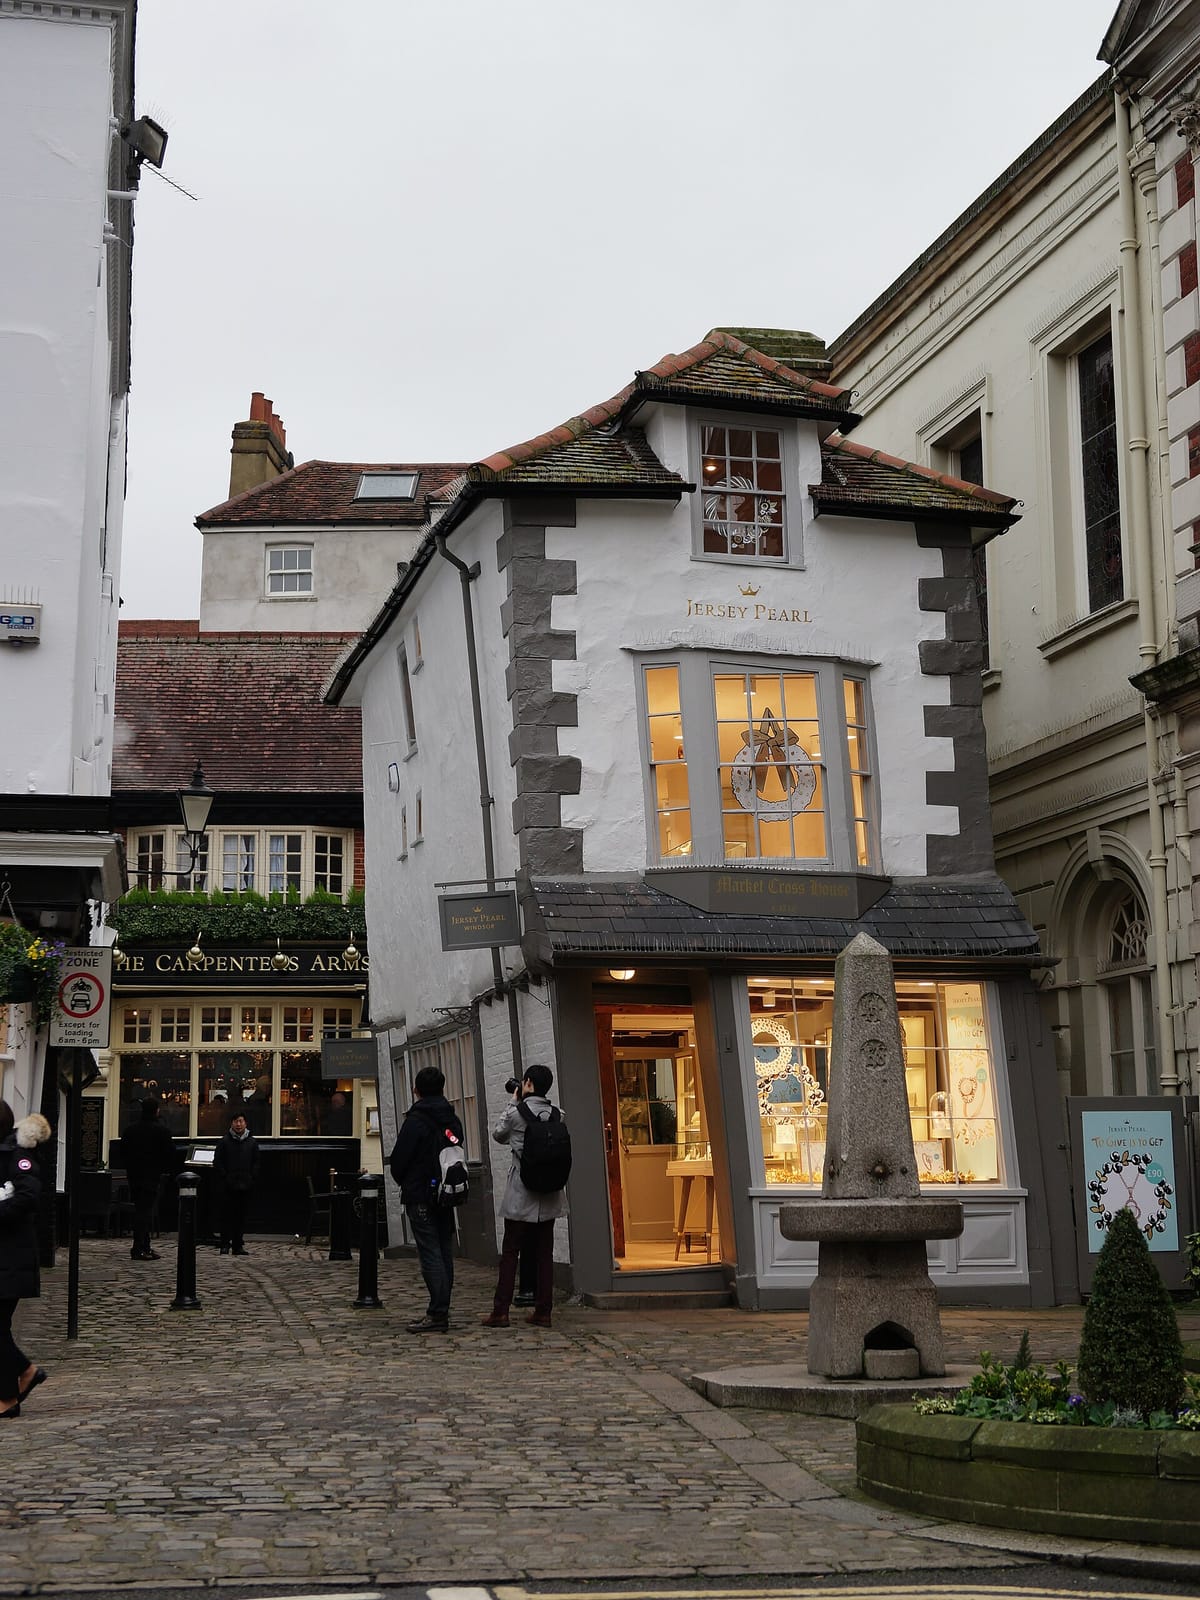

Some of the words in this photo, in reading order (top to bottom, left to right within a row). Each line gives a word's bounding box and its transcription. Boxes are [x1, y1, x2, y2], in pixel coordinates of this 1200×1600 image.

[687, 599, 748, 619] JERSEY
[754, 604, 813, 623] PEARL
[715, 876, 763, 896] Market
[767, 879, 806, 896] Cross
[451, 915, 478, 925] JERSEY
[480, 914, 505, 922] PEARL
[66, 957, 100, 967] ZONE
[58, 1022, 85, 1030] Except
[64, 1029, 94, 1037] loading
[1106, 1138, 1127, 1148] GIVE
[1149, 1137, 1164, 1147] GET
